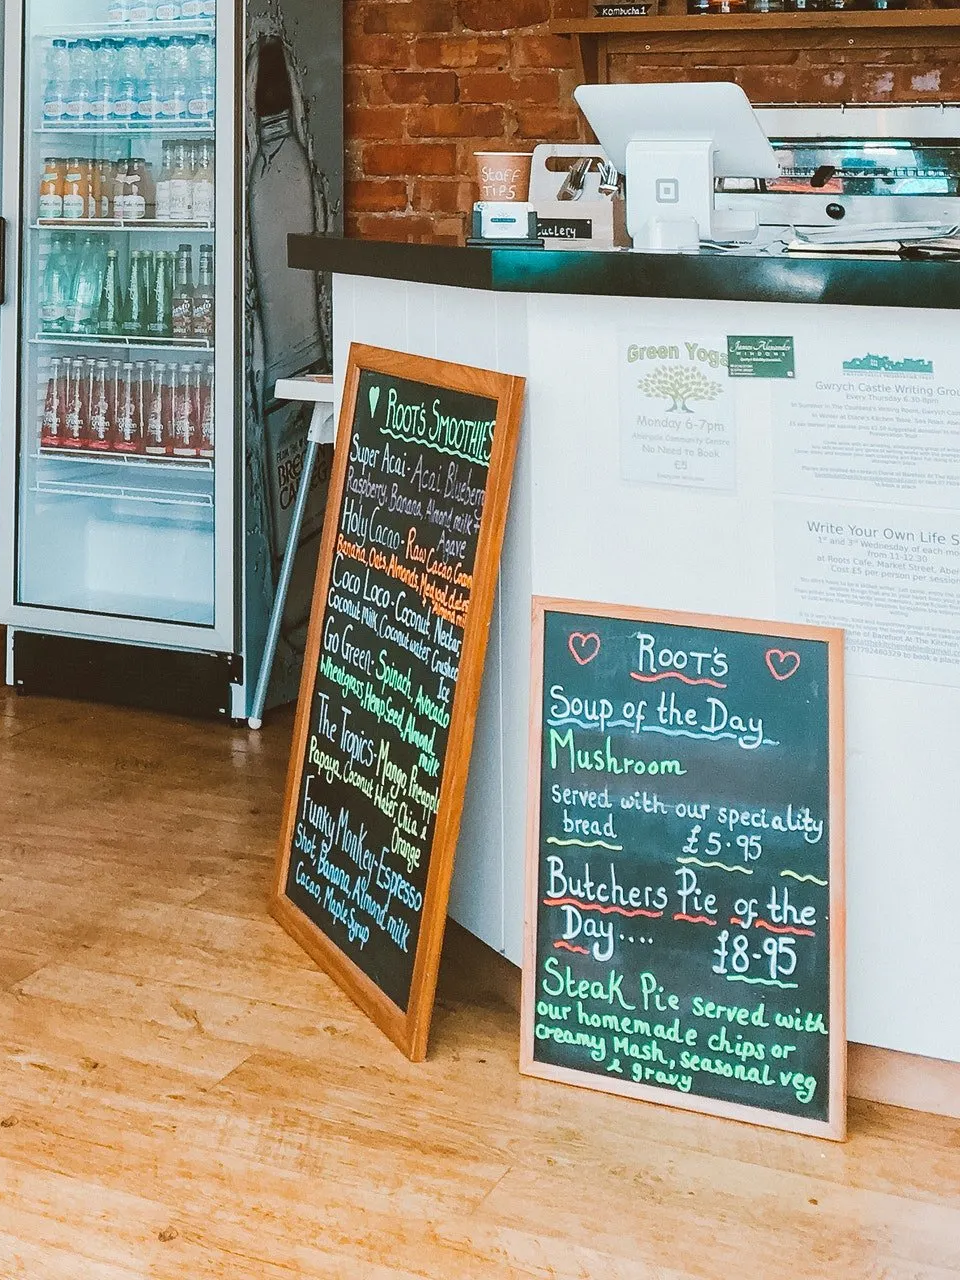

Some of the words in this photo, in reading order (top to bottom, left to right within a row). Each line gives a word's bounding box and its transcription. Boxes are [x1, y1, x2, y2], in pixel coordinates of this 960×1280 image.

[627, 343, 680, 363] Green
[815, 380, 855, 392] Gwrych
[858, 382, 891, 393] Castle
[894, 384, 934, 397] Writing
[637, 415, 682, 430] Monday
[685, 418, 725, 433] 6-7pm
[350, 433, 380, 475] Super
[698, 448, 720, 458] Book
[341, 497, 369, 548] Holy
[405, 527, 426, 563] Raw
[436, 530, 467, 564] Agave
[807, 520, 844, 535] Write
[848, 524, 881, 538] Your
[883, 528, 915, 541] Own
[920, 531, 946, 545] Life
[830, 537, 845, 546] and
[860, 540, 909, 552] Wednesday
[911, 545, 920, 553] of
[922, 546, 944, 555] each
[332, 553, 361, 594] Coco
[828, 555, 850, 565] Roots
[877, 560, 906, 570] Market
[831, 564, 849, 574] Cost
[865, 570, 878, 578] per
[881, 571, 910, 581] person
[913, 574, 927, 583] per
[867, 550, 887, 559] from
[328, 587, 360, 620] Coconut
[379, 615, 409, 650] Coconut
[324, 616, 340, 654] Go
[414, 685, 450, 729] Avocado
[436, 676, 450, 703] Ice
[318, 692, 338, 743] The
[363, 681, 386, 724] Hemp
[403, 712, 437, 756] Almond
[549, 685, 613, 732] Soup
[622, 701, 647, 733] of
[657, 691, 697, 725] the
[701, 697, 763, 750] Day
[418, 752, 440, 777] milk
[549, 728, 688, 776] Mushroom
[343, 761, 374, 799] Coconut
[398, 802, 418, 836] Chia
[620, 792, 668, 815] with
[675, 803, 710, 820] our
[718, 804, 823, 843] speciality
[302, 775, 336, 853] Funky
[376, 846, 423, 912] Espresso
[563, 809, 618, 838] bread
[391, 826, 421, 874] Orange
[352, 875, 389, 931] Almond
[387, 915, 411, 953] milk
[546, 855, 668, 910] Butchers
[675, 865, 718, 914] Pie
[734, 899, 758, 929] of
[767, 886, 816, 925] the
[323, 885, 349, 925] Maple
[348, 908, 370, 951] Syrup
[640, 972, 680, 1011] Pie
[775, 1007, 828, 1035] with
[536, 1000, 572, 1020] our
[577, 1001, 698, 1046] homemade
[707, 1026, 765, 1061] chips
[770, 1043, 797, 1059] or
[535, 1023, 606, 1061] creamy
[680, 1050, 775, 1087] seasonal
[778, 1070, 817, 1104] veg
[632, 1062, 692, 1093] gravy
